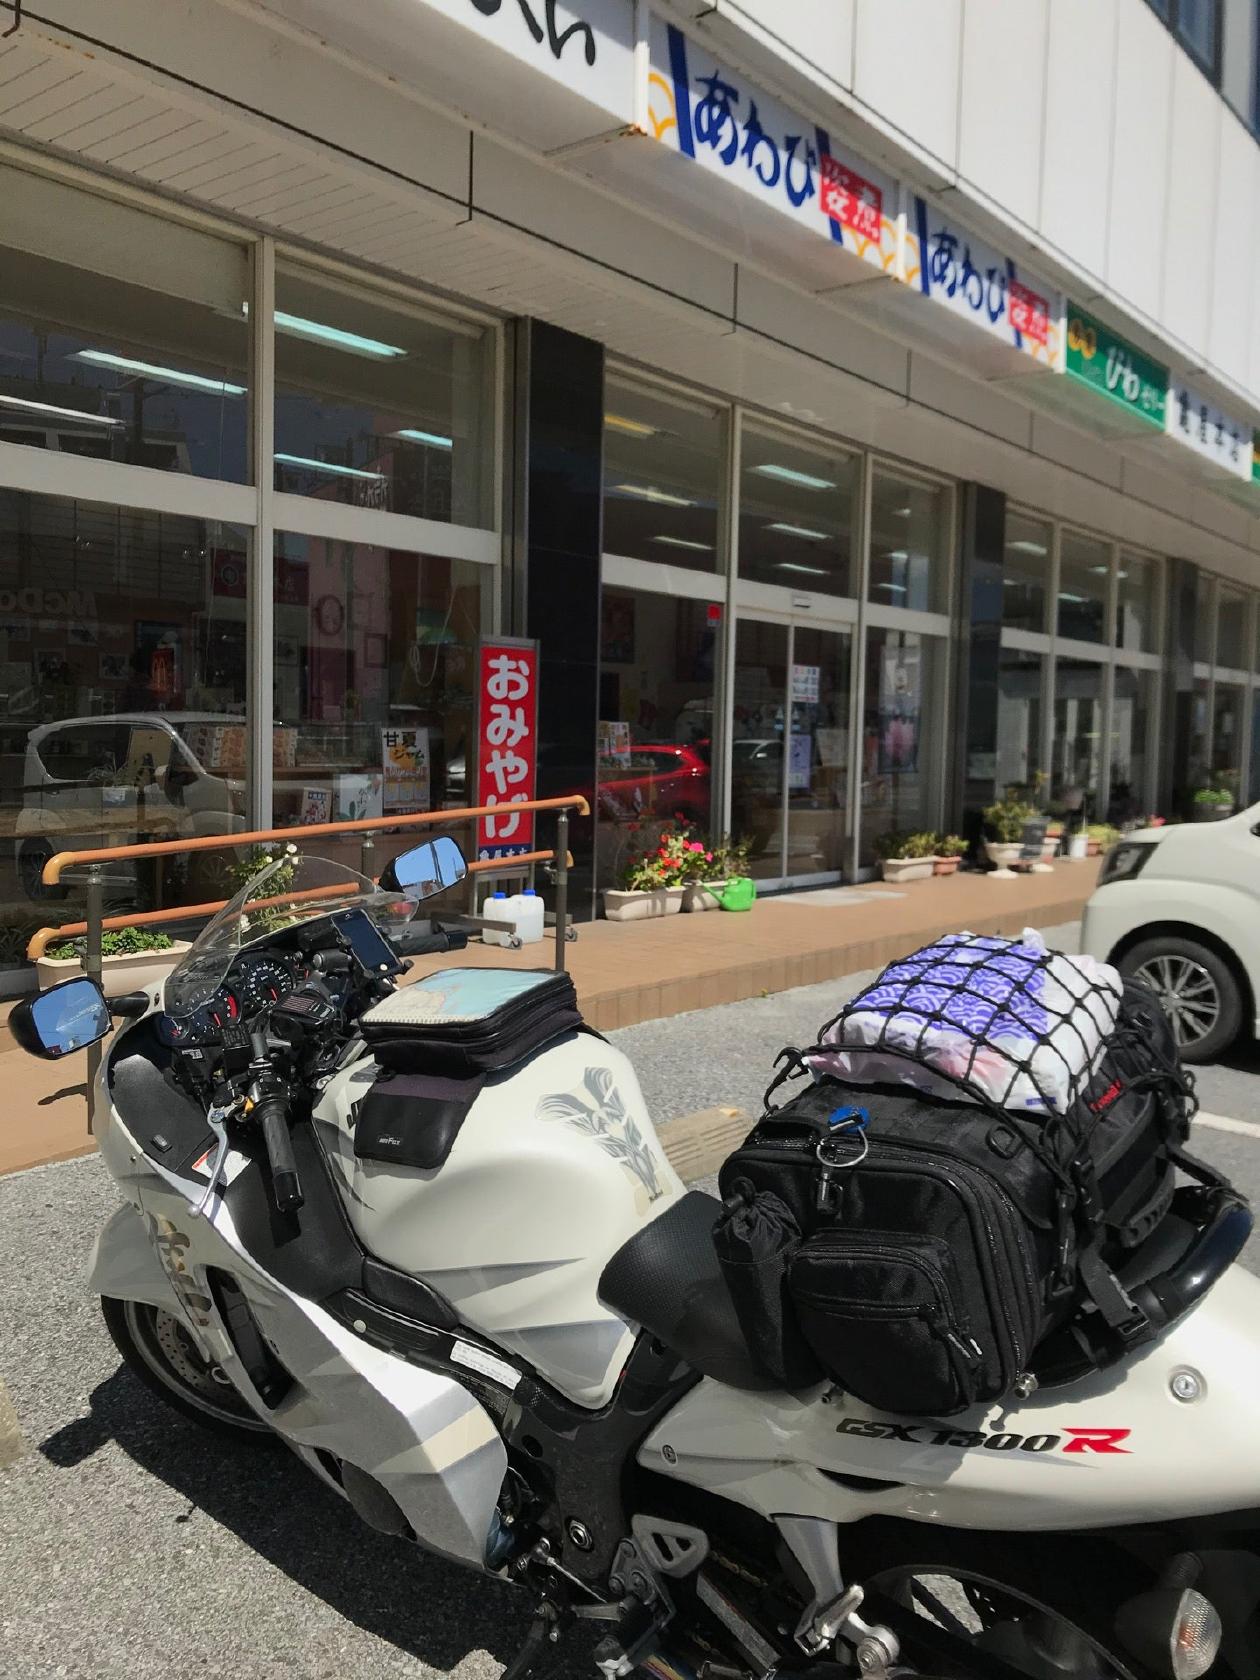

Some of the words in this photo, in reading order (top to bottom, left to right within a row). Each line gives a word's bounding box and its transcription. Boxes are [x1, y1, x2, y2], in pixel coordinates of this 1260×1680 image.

[694, 69, 816, 207] あわび
[931, 226, 1006, 323] あわび
[1105, 346, 1140, 401] びわ
[383, 731, 417, 747] 甘夏
[485, 654, 529, 838] おみやげ
